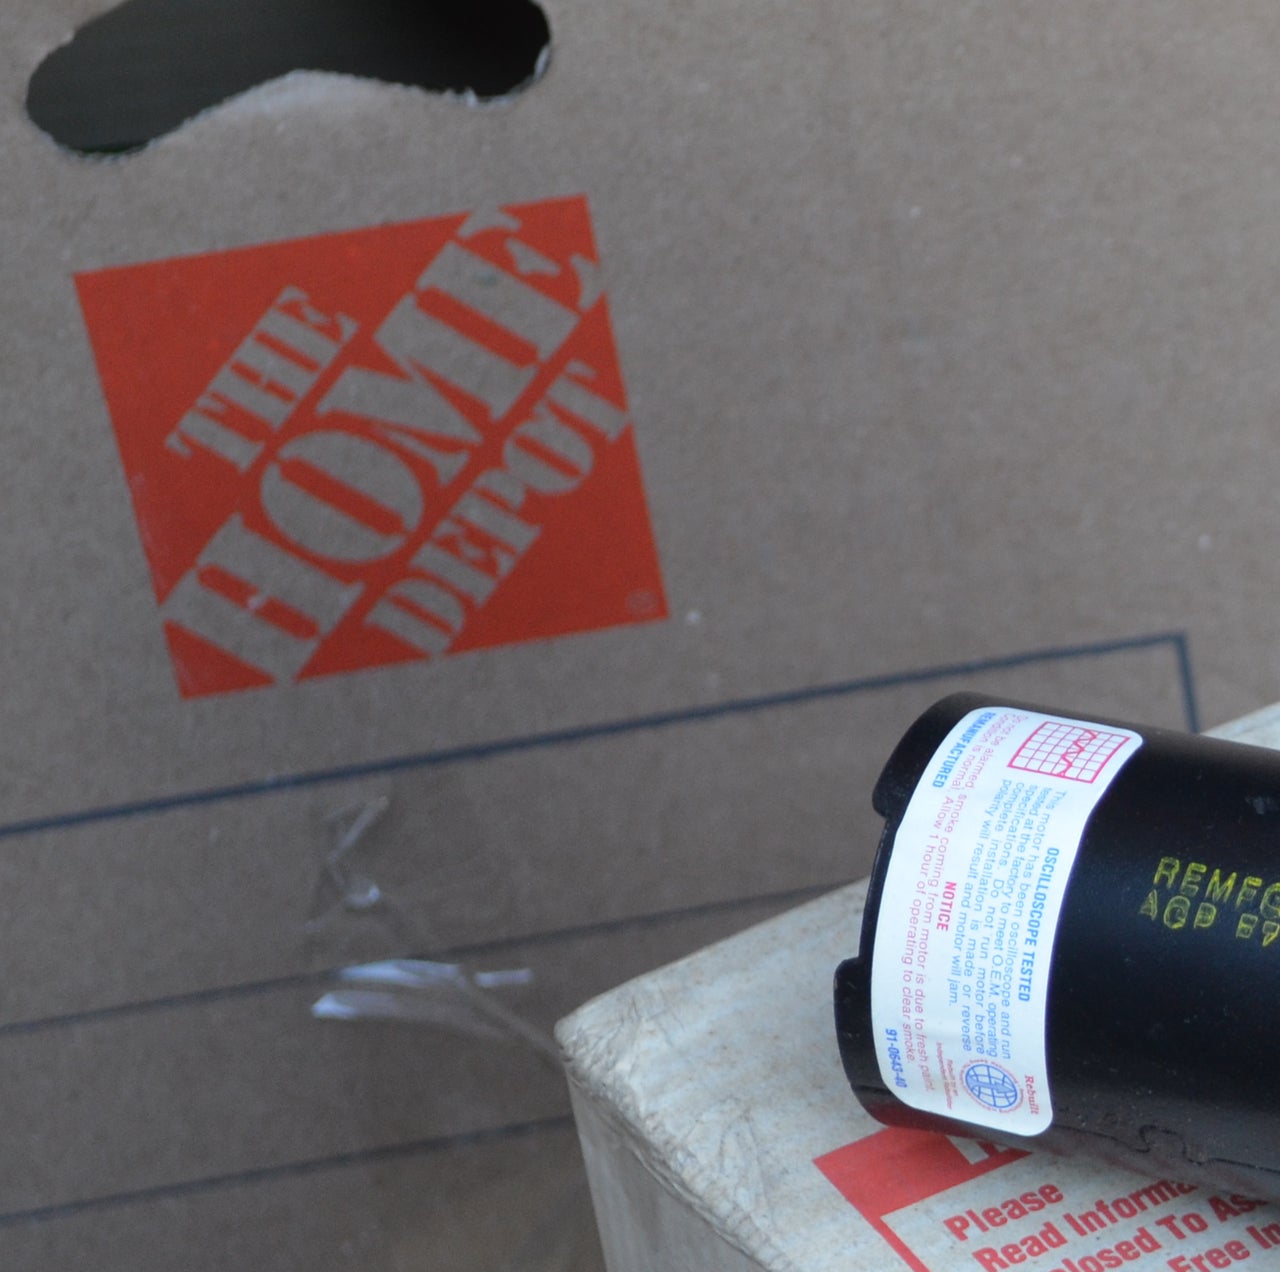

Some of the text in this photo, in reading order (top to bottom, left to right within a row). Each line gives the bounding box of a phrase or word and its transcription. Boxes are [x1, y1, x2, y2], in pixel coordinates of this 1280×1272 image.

[164, 284, 360, 474] THE
[159, 206, 600, 686] HOME
[362, 359, 633, 657] DEPOT
[931, 712, 995, 788] REMANUFACTURED
[932, 796, 954, 828] Allow
[943, 794, 967, 832] smoke
[1023, 818, 1034, 829] at
[979, 820, 991, 838] will
[1016, 834, 1030, 852] the
[1031, 813, 1050, 850] motor
[919, 845, 935, 877] hour
[926, 838, 949, 887] coming
[967, 843, 983, 877] result
[973, 839, 999, 911] installation
[1001, 856, 1024, 897] factory
[1022, 854, 1039, 878] has
[915, 881, 925, 894] of
[960, 882, 973, 907] and
[990, 879, 1004, 897] Do
[1012, 883, 1030, 916] been
[924, 892, 937, 923] from
[936, 882, 956, 930] NOTICE
[983, 906, 995, 927] not
[1000, 902, 1011, 913] to
[900, 899, 921, 965] operating
[952, 912, 967, 951] motor
[969, 919, 981, 930] is
[994, 918, 1007, 950] meet
[1016, 847, 1059, 1001] OSCILLOSCOPE TESTED
[916, 929, 929, 968] motor
[963, 938, 977, 976] made
[979, 936, 990, 959] run
[902, 970, 912, 982] to
[915, 973, 925, 984] is
[951, 956, 960, 975] will
[989, 954, 1004, 996] O.E.M.
[1000, 922, 1019, 1007] oscilloscope
[901, 986, 911, 1019] clear
[914, 988, 925, 1013] due
[947, 979, 957, 1006] jam.
[962, 984, 970, 997] or
[974, 967, 985, 1007] motor
[914, 1018, 923, 1029] to
[962, 1005, 970, 1051] reverse
[975, 1015, 984, 1053] before
[987, 1003, 996, 1057] operating
[1000, 1012, 1010, 1035] and
[902, 1023, 913, 1062] smoke.
[916, 1034, 927, 1062] fresh
[1002, 1040, 1010, 1059] run
[1025, 1074, 1038, 1114] Rebuilt
[943, 1183, 1064, 1241] Please
[1063, 1179, 1199, 1237] Informa
[1155, 1211, 1209, 1240] To
